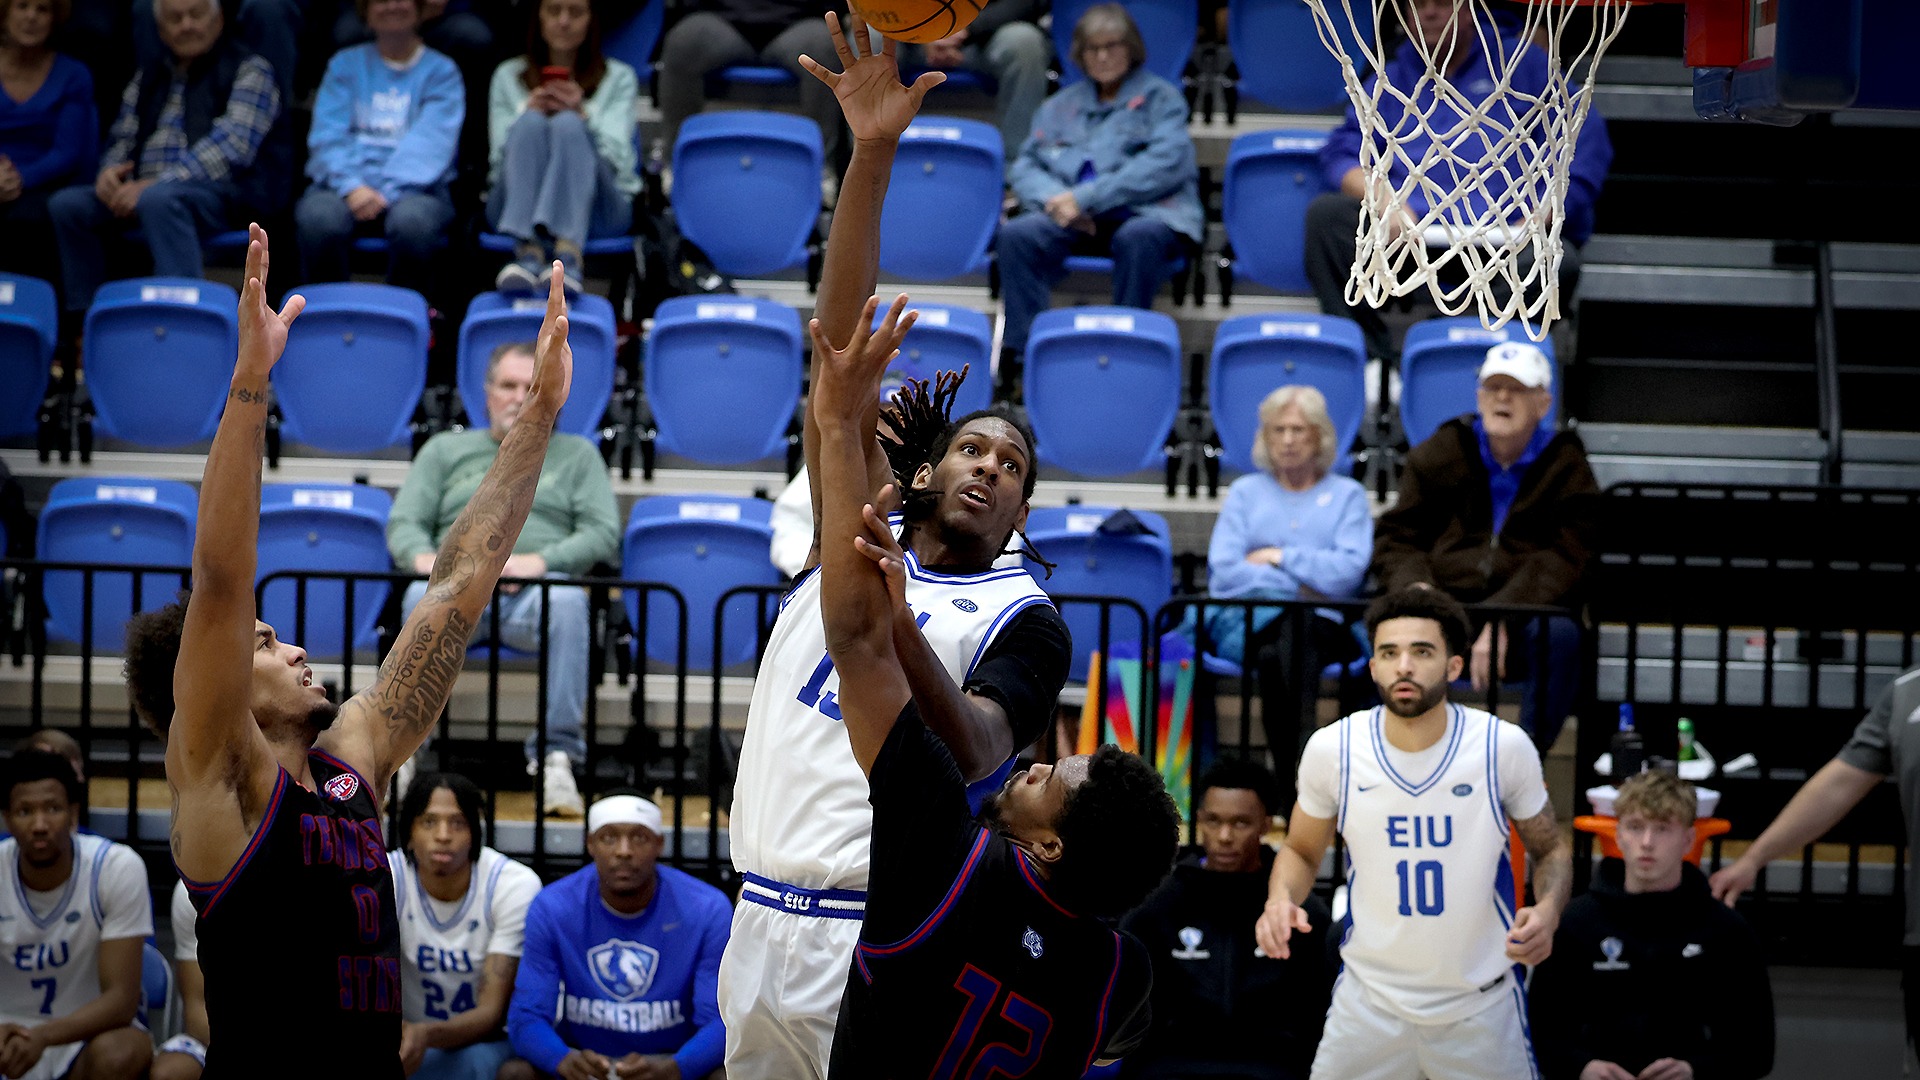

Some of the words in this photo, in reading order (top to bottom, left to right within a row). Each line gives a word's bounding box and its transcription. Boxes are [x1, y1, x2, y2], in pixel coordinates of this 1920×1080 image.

[386, 616, 437, 700] Forever
[1385, 815, 1452, 848] EIU
[783, 891, 812, 911] EIU
[1396, 860, 1444, 916] 10
[14, 941, 69, 971] EIU
[417, 945, 473, 973] EIU
[31, 978, 57, 1014] 7
[421, 979, 477, 1020] 24
[565, 994, 685, 1034] BASKETBALL
[928, 962, 1053, 1080] 12
